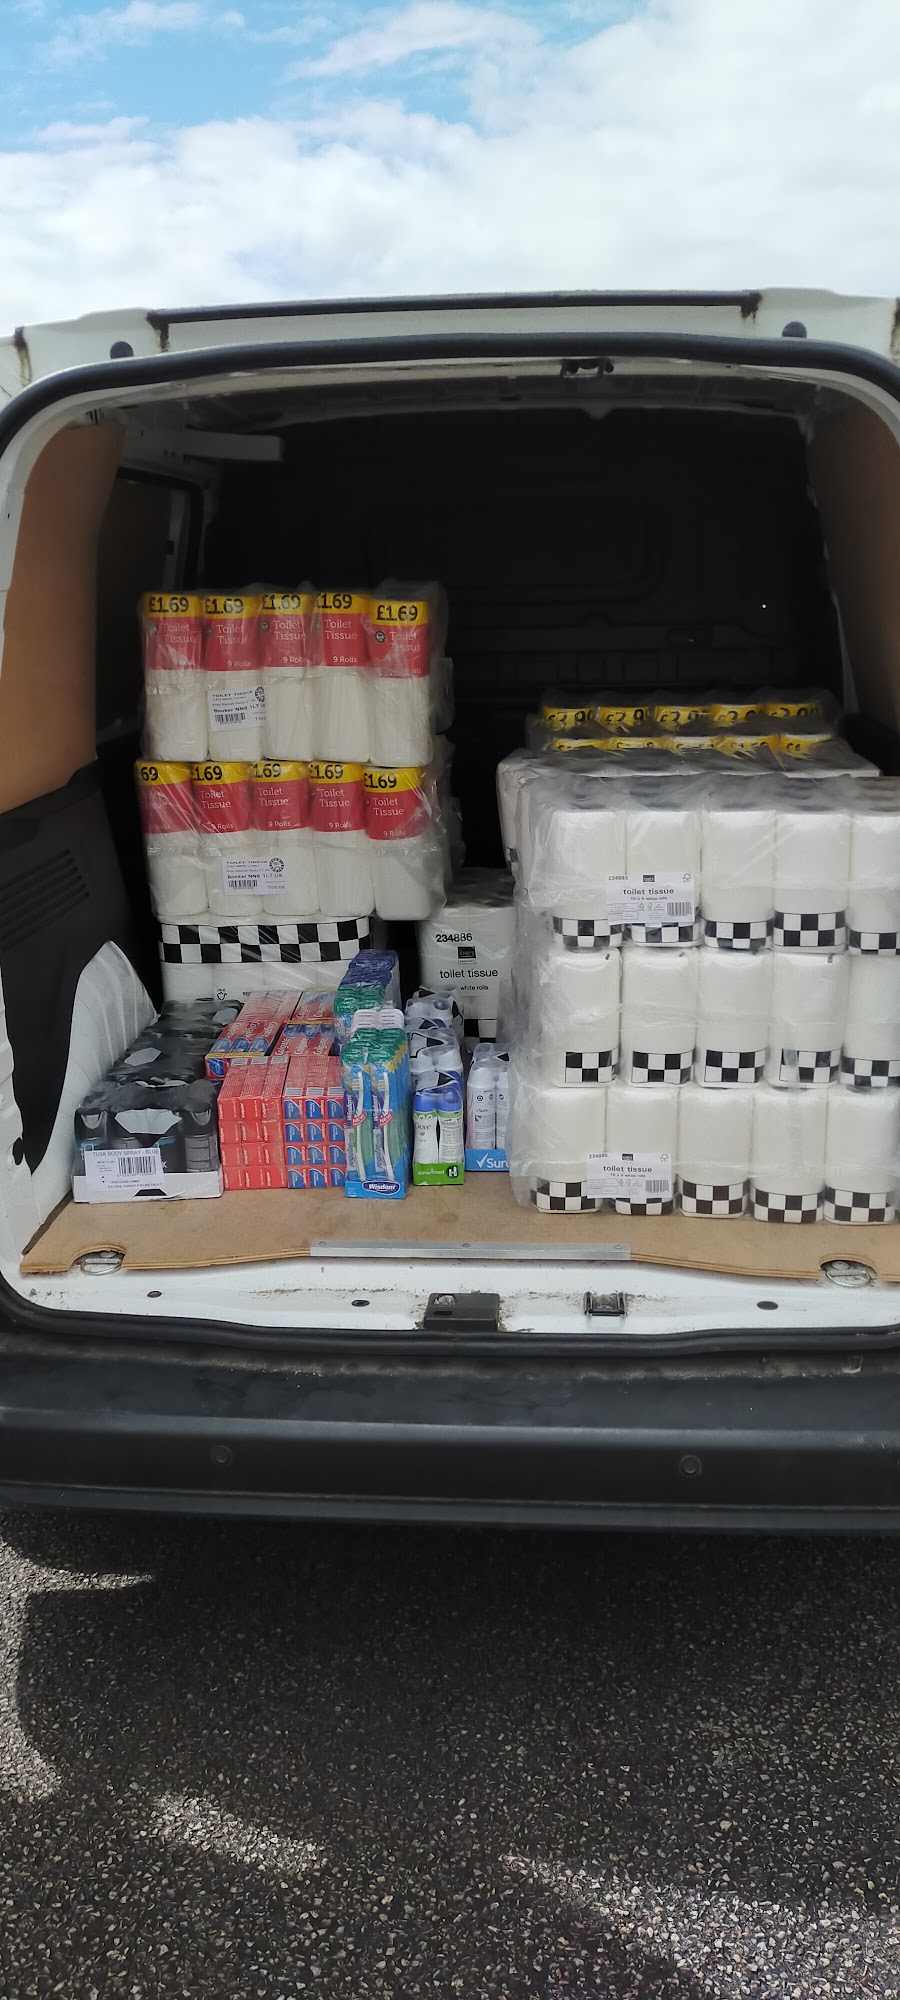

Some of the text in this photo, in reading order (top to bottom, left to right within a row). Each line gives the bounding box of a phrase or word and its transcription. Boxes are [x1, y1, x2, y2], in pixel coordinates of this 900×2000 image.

[149, 596, 189, 612] £1.69
[205, 598, 244, 614] £1.69
[376, 604, 418, 622] £1.69
[273, 620, 301, 630] Toilet
[324, 619, 352, 630] Toilet
[325, 630, 358, 640] Tissue
[227, 660, 233, 668] 9
[200, 790, 224, 799] Toilet
[258, 787, 284, 796] Toilet
[317, 788, 344, 798] Toilet
[201, 800, 231, 810] Tissue
[259, 798, 289, 807] Tissue
[320, 799, 350, 808] Tissue
[372, 798, 399, 806] Toilet
[374, 808, 404, 816] Tissue
[435, 932, 473, 942] 234886
[440, 968, 498, 978] toilet tissue
